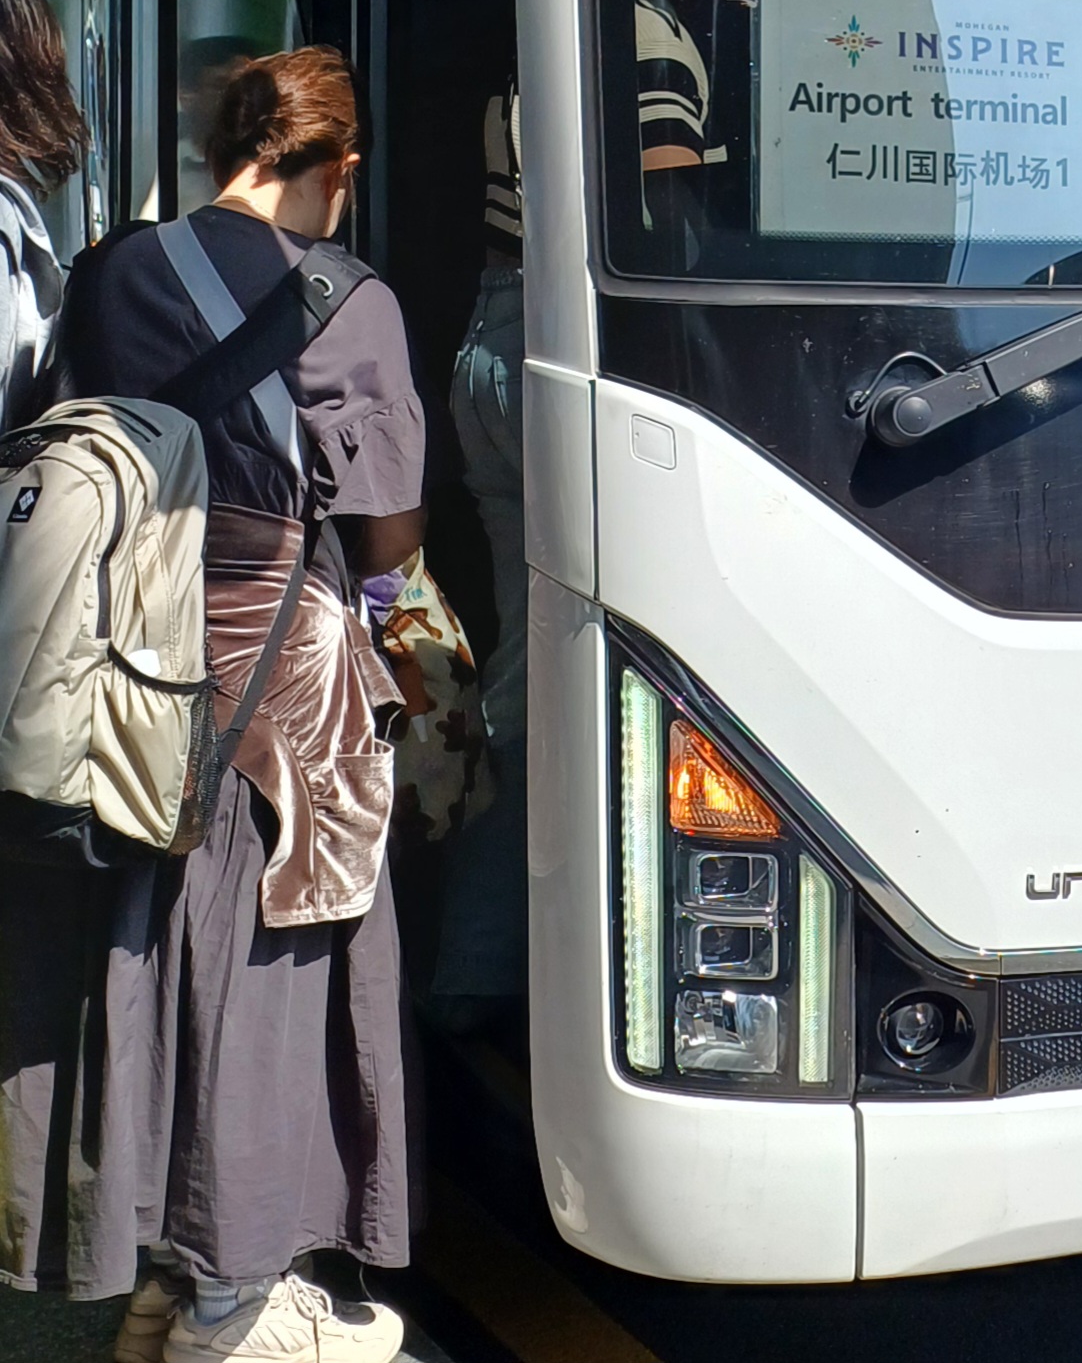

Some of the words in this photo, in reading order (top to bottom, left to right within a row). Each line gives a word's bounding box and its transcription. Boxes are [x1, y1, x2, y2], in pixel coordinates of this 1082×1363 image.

[955, 21, 1010, 32] MOHEGAN
[898, 31, 1066, 68] INSPIRE
[913, 64, 1004, 77] ENTERTAINMENT
[1010, 69, 1050, 80] RESORT
[788, 82, 912, 123] Airport
[930, 92, 1068, 126] terminal
[826, 143, 1069, 189] 仁川国际机场1
